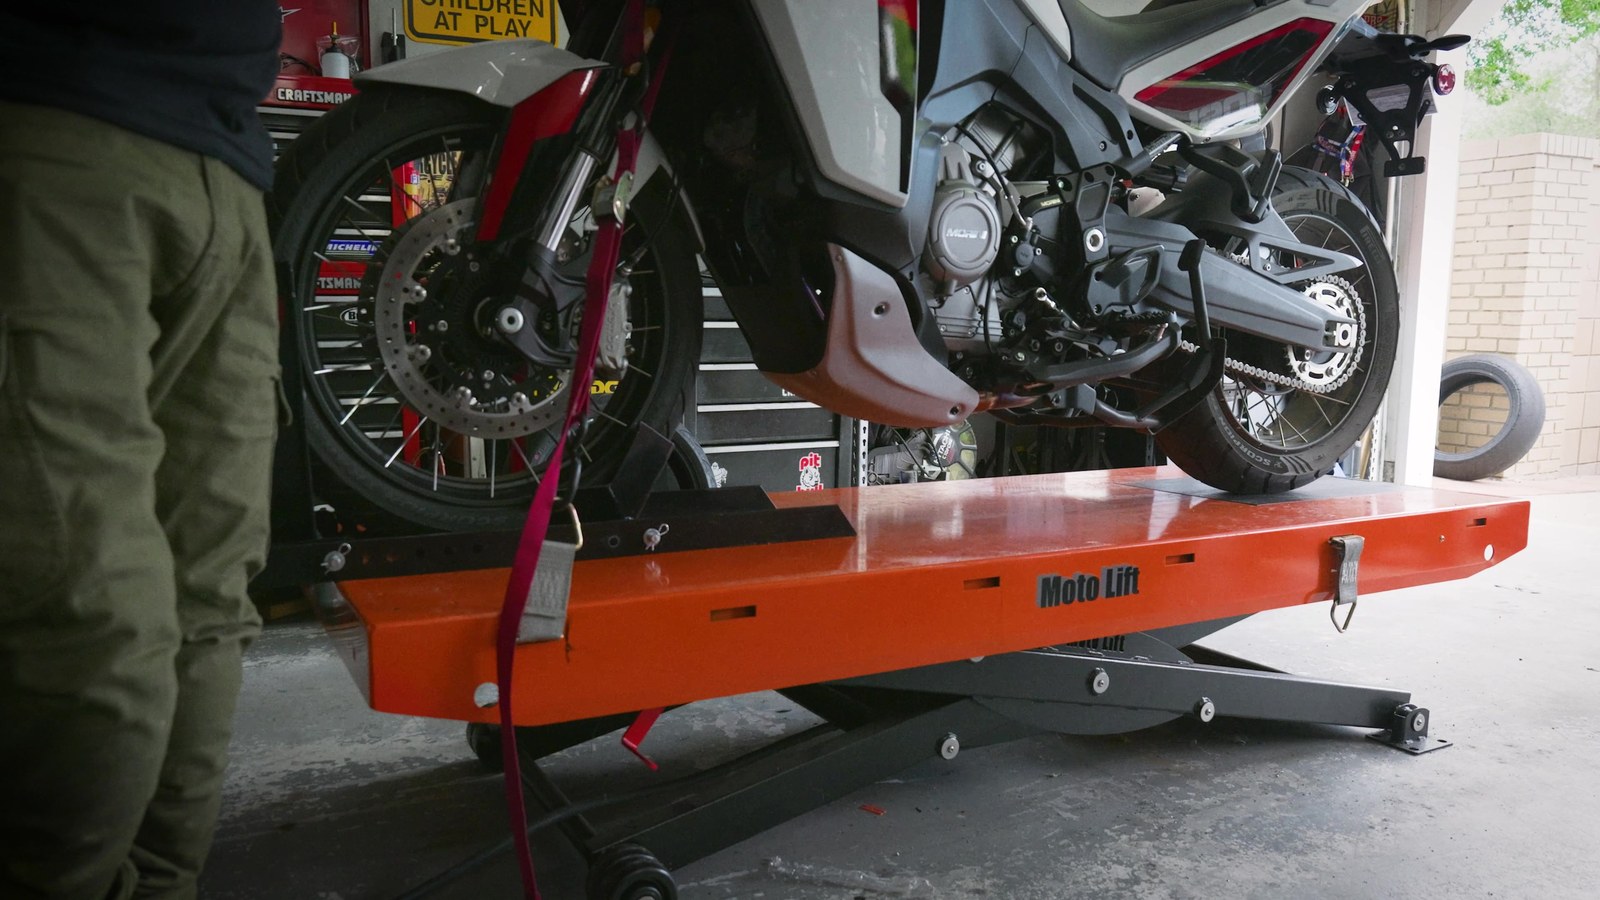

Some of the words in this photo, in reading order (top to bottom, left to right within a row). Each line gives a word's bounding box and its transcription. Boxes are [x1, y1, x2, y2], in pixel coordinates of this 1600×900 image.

[421, 0, 544, 18] LDREN
[434, 11, 462, 31] AT
[475, 14, 531, 37] PLAY
[278, 88, 352, 104] CRAFTSMAN
[317, 277, 361, 289] TSMAN
[1219, 416, 1271, 466] SCORPION
[800, 453, 820, 470] pit
[1037, 572, 1100, 608] Moto
[1101, 564, 1140, 598] Lift
